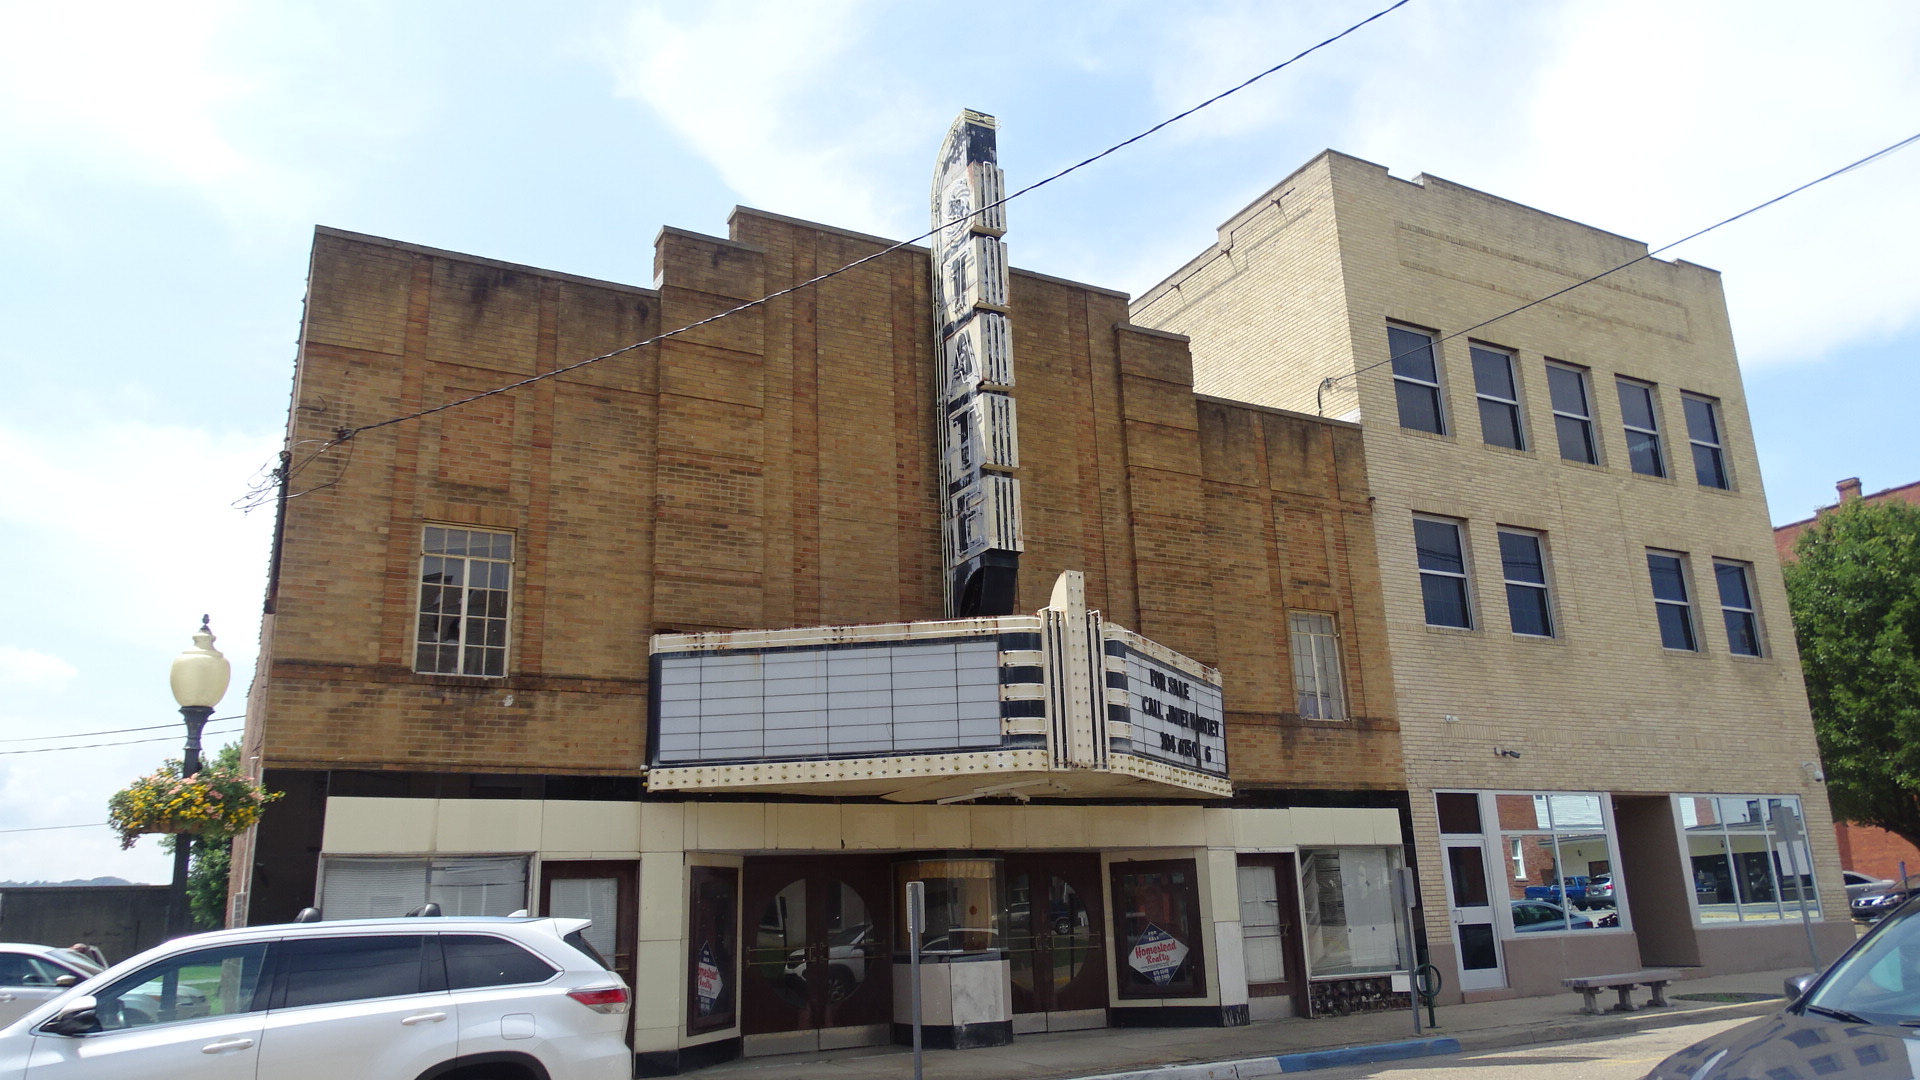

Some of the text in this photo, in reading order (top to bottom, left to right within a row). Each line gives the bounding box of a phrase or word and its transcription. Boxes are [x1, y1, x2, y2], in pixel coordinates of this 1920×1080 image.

[942, 179, 983, 557] STATE
[1150, 668, 1190, 700] FOR SALE
[1142, 696, 1164, 720] CALL
[1160, 732, 1176, 753] 304
[1135, 940, 1177, 959] Homestead
[1145, 953, 1170, 964] Realty
